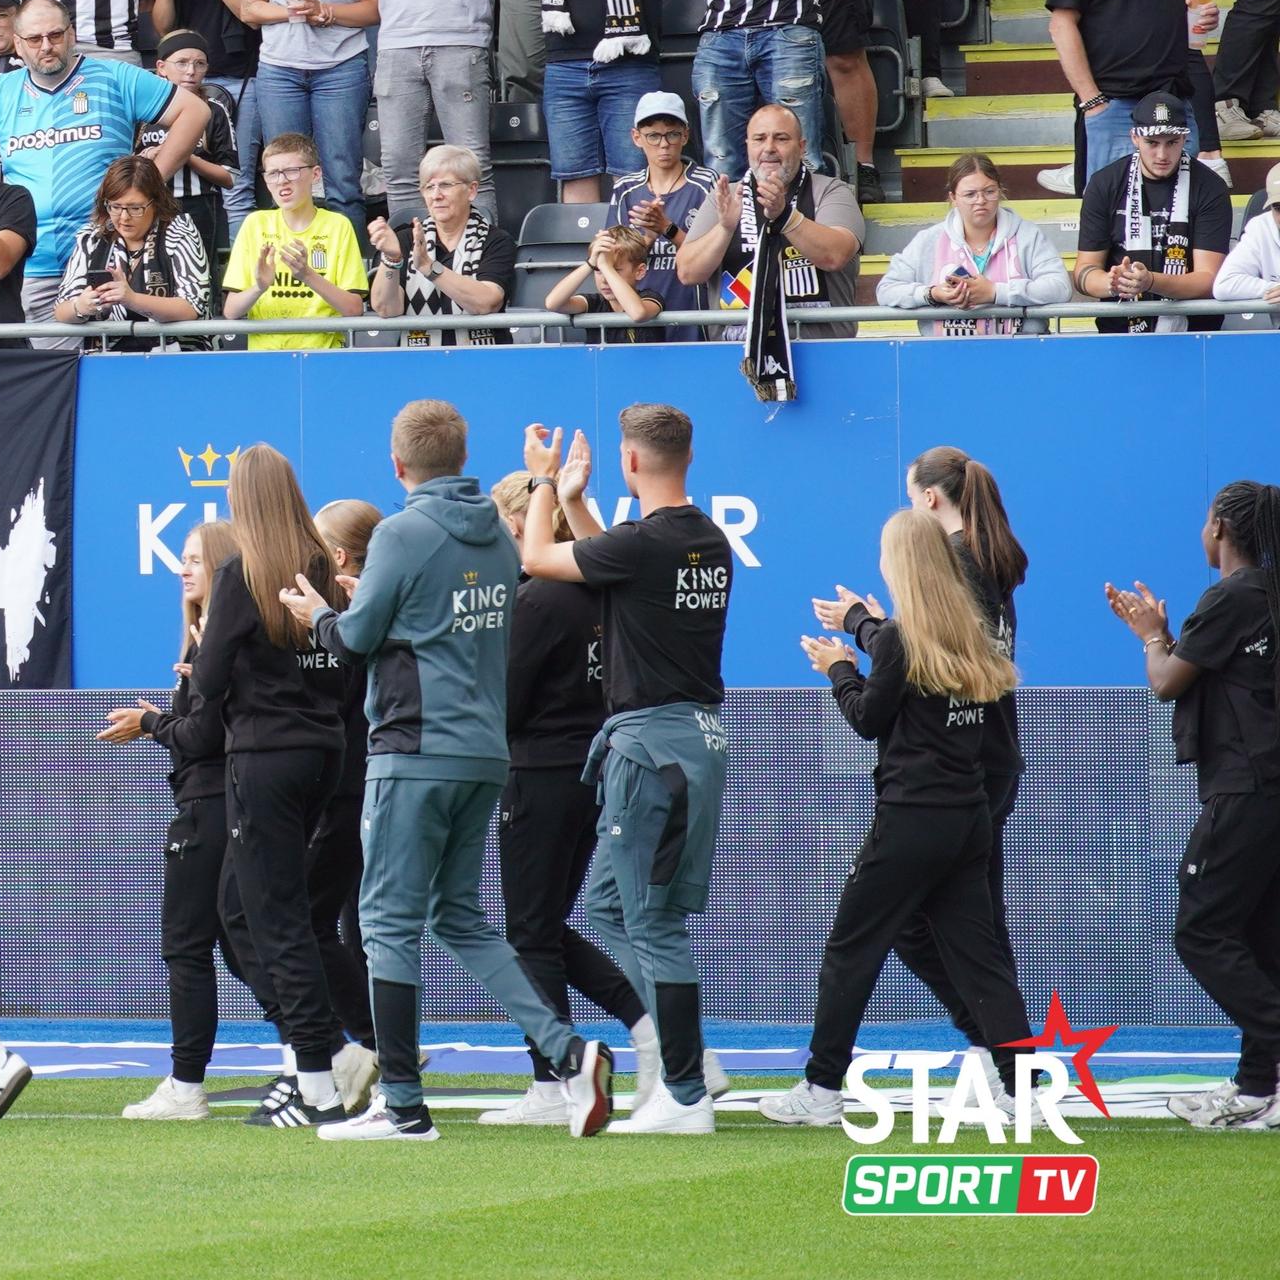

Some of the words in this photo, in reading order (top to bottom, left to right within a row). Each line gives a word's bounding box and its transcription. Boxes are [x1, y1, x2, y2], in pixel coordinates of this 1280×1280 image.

[6, 124, 103, 157] proximus
[675, 567, 728, 592] KING
[452, 584, 507, 611] KING
[675, 592, 727, 611] POWER
[451, 612, 505, 635] POWER
[295, 654, 340, 670] OWER
[694, 711, 725, 735] KIN
[945, 707, 986, 728] POWE
[703, 732, 729, 752] POW
